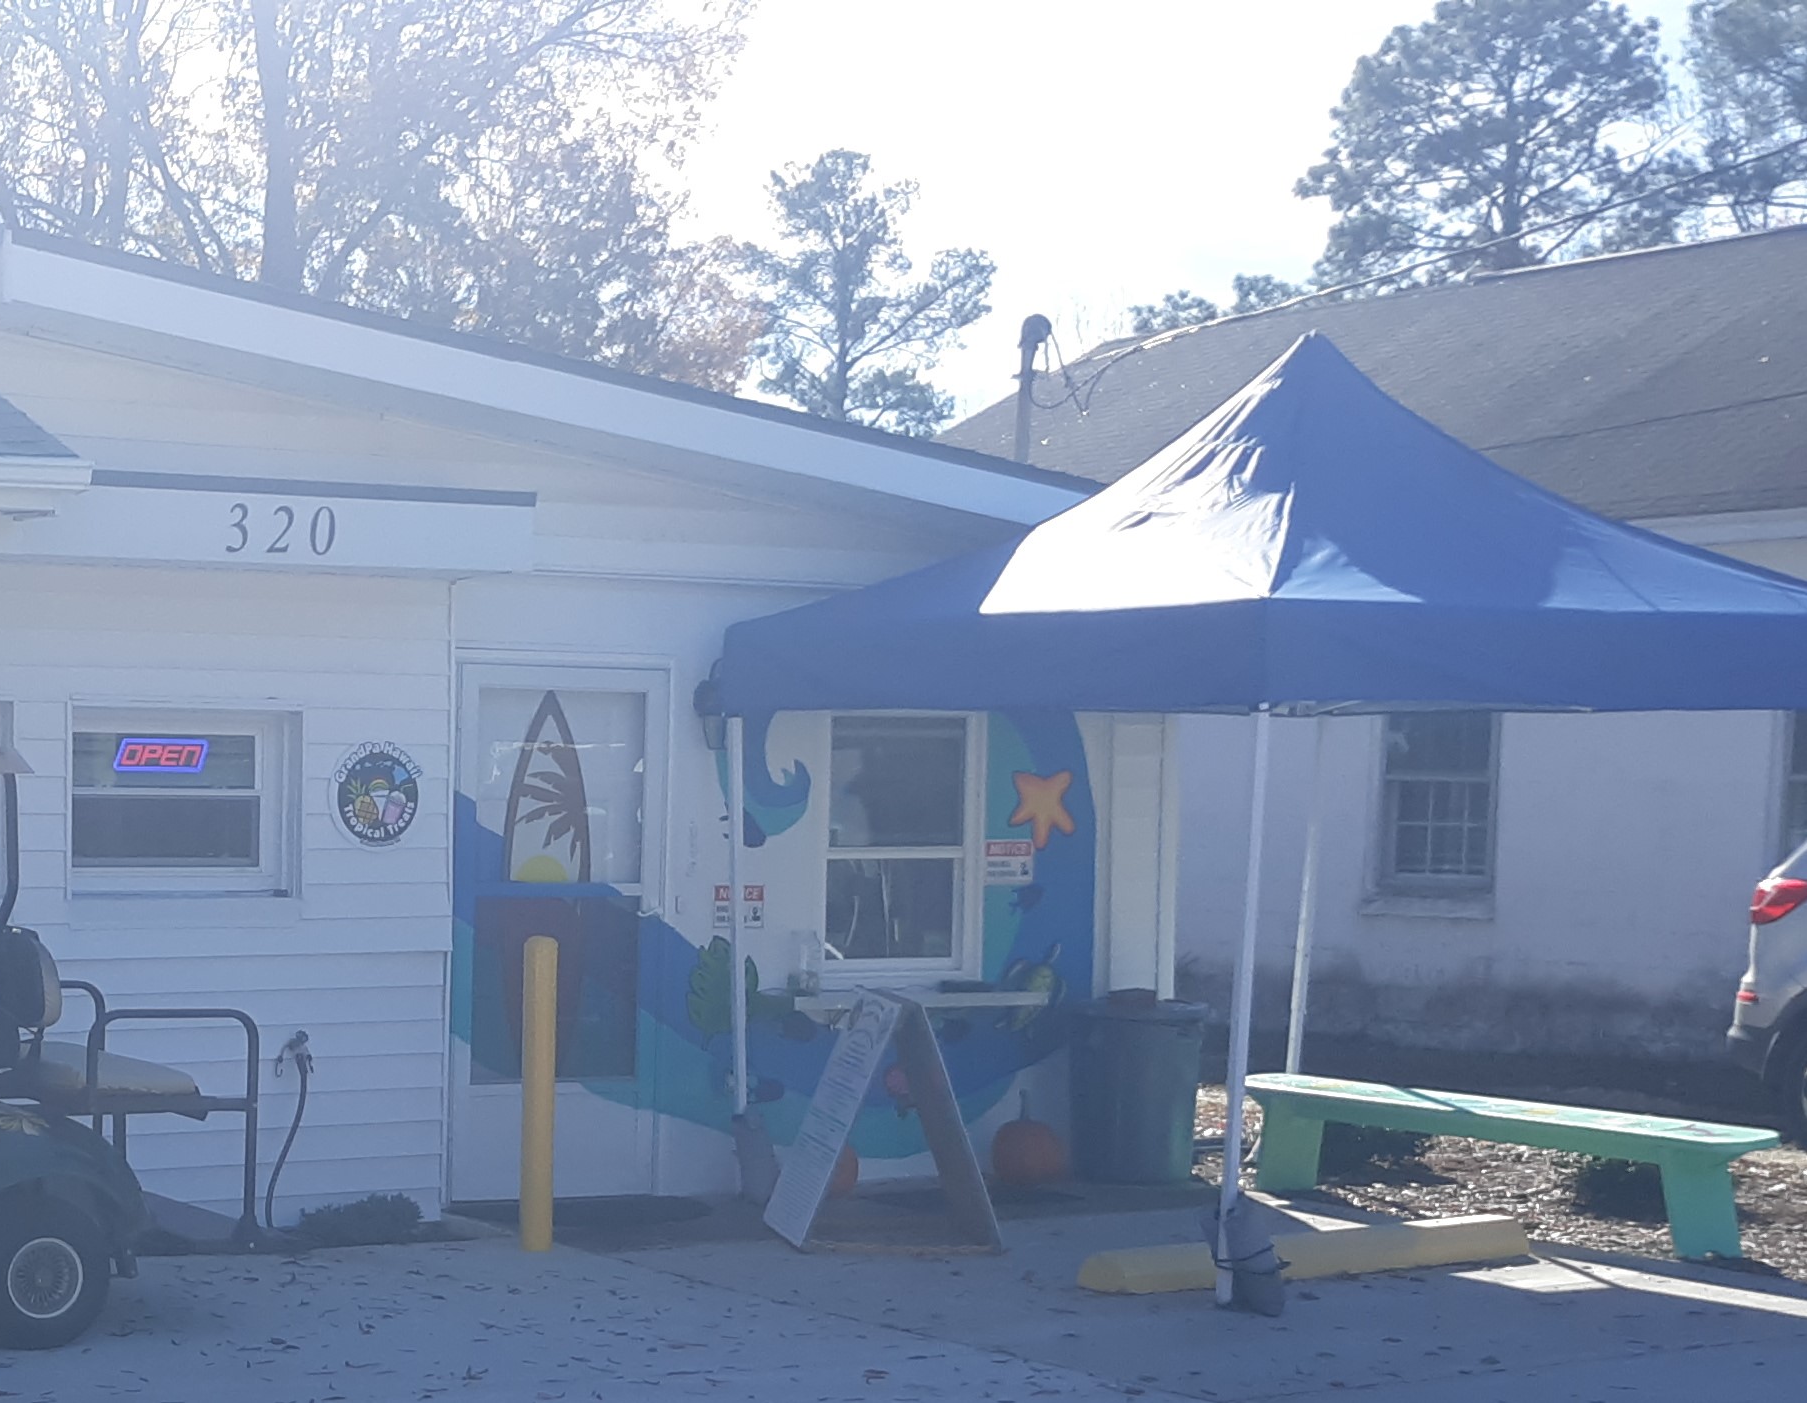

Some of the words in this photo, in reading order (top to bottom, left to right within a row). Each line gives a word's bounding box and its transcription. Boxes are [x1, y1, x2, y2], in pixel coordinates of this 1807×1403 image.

[225, 503, 336, 555] 320
[120, 745, 202, 766] OPEN
[334, 741, 380, 783] GrandPa
[383, 741, 423, 779] Hawaii
[344, 803, 385, 838] Tropical
